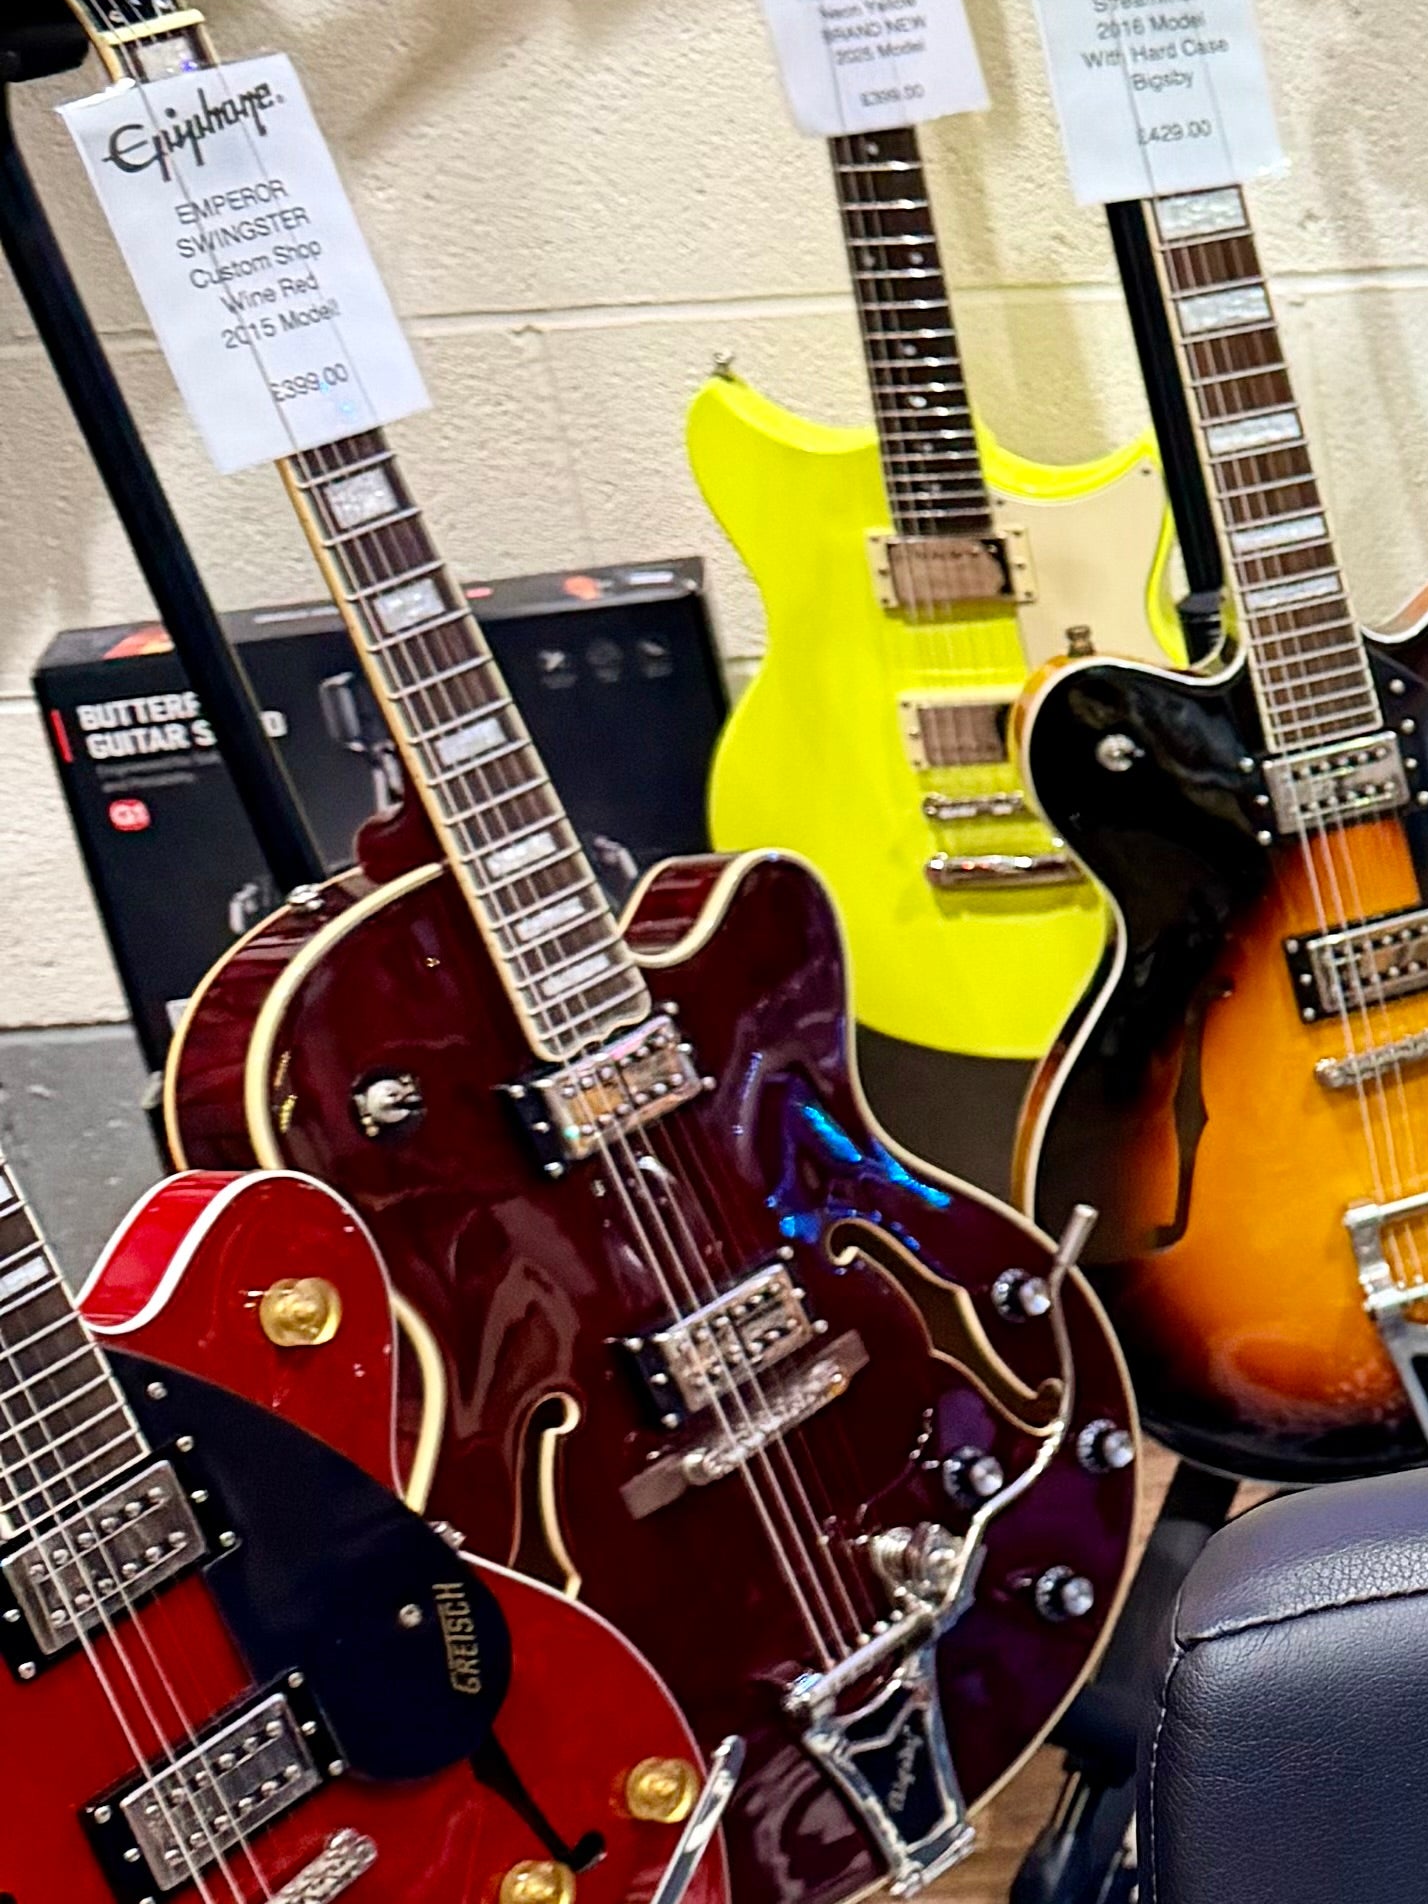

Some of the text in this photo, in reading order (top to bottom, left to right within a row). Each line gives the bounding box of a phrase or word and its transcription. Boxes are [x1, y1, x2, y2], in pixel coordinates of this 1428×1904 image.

[1149, 13, 1206, 37] Model
[1081, 36, 1230, 69] With Hard Case
[1129, 68, 1195, 94] Bigsby
[175, 178, 289, 226] EMPEROR
[175, 205, 311, 259] SWINGSTER
[189, 238, 323, 290] Custom Shop
[220, 274, 320, 315] Wine Red
[223, 317, 275, 350] 2015
[269, 361, 350, 404] £399.00
[86, 722, 190, 760] GUITAR
[432, 1582, 482, 1694] GRETSCH
